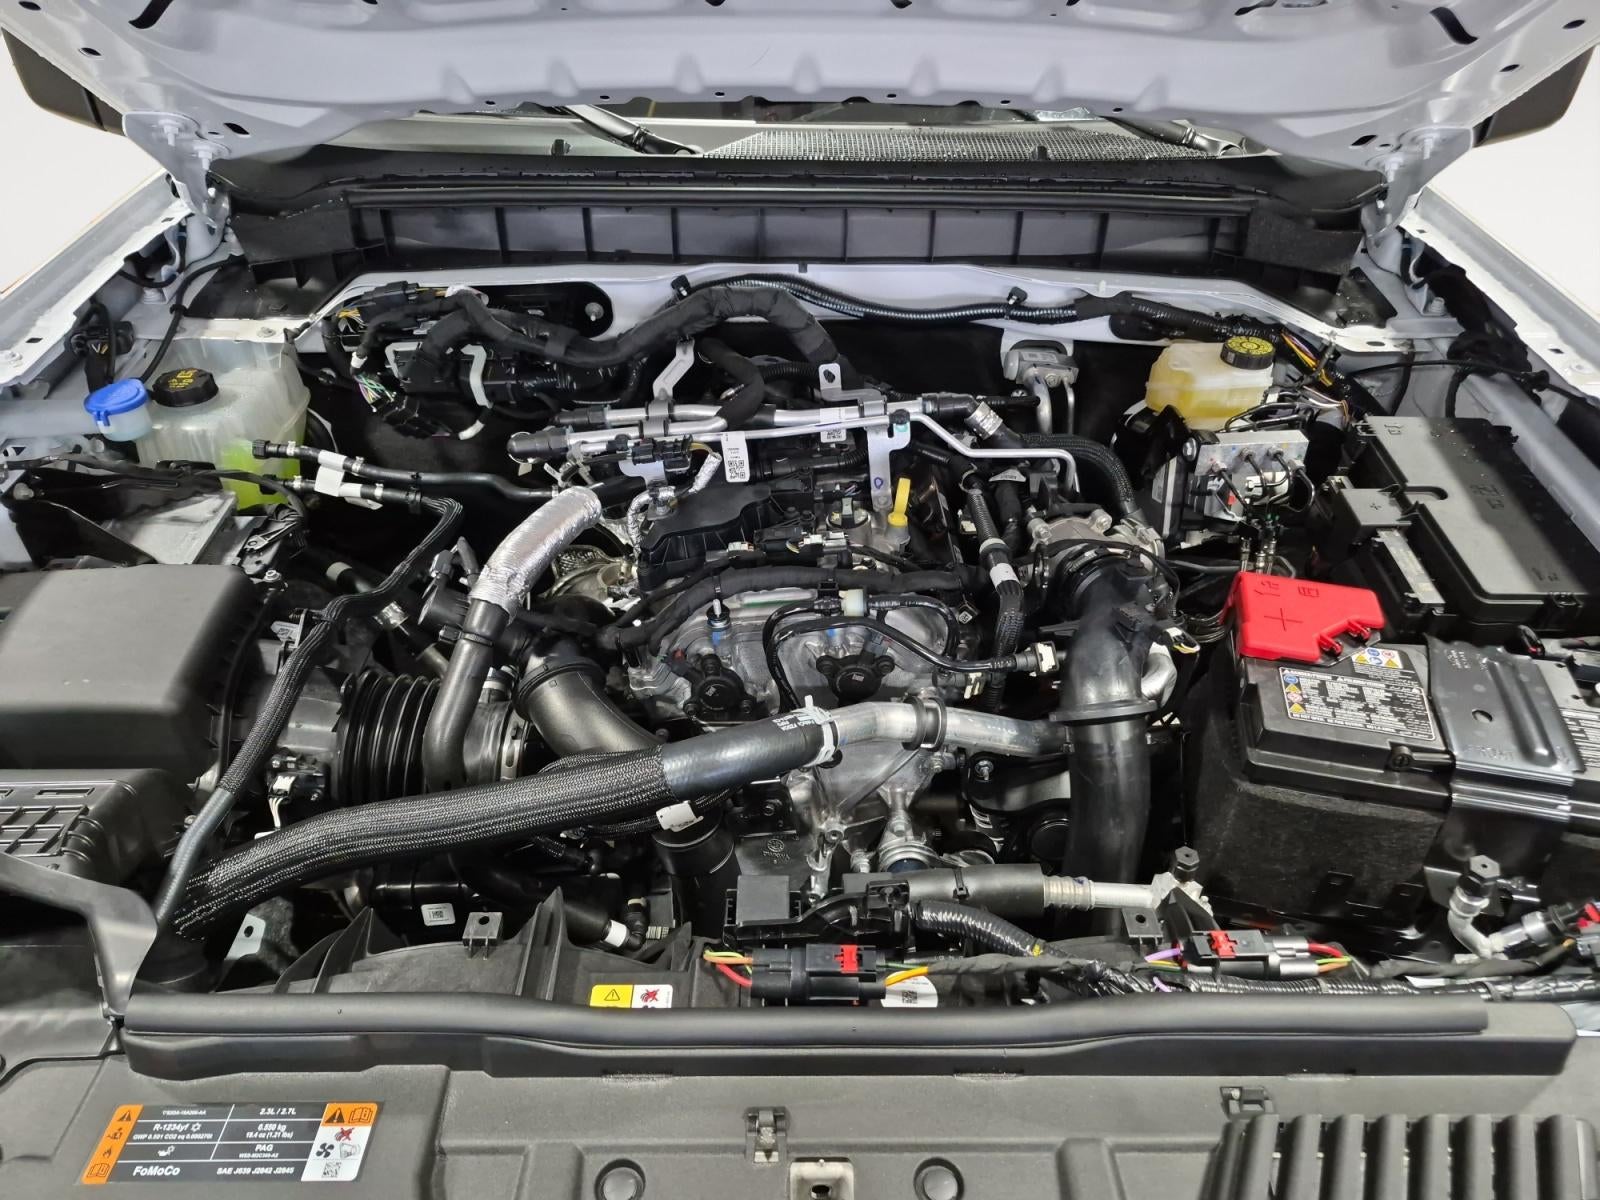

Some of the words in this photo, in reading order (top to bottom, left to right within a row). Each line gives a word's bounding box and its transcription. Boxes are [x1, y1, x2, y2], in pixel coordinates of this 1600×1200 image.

[260, 1107, 275, 1115] 2.3L
[281, 1107, 296, 1115] 2.7L
[153, 1123, 189, 1132] R-1234yf
[277, 1123, 287, 1132] kg
[255, 1144, 274, 1152] PAG
[132, 1165, 181, 1177] FoMoCo
[216, 1167, 233, 1175] SAE
